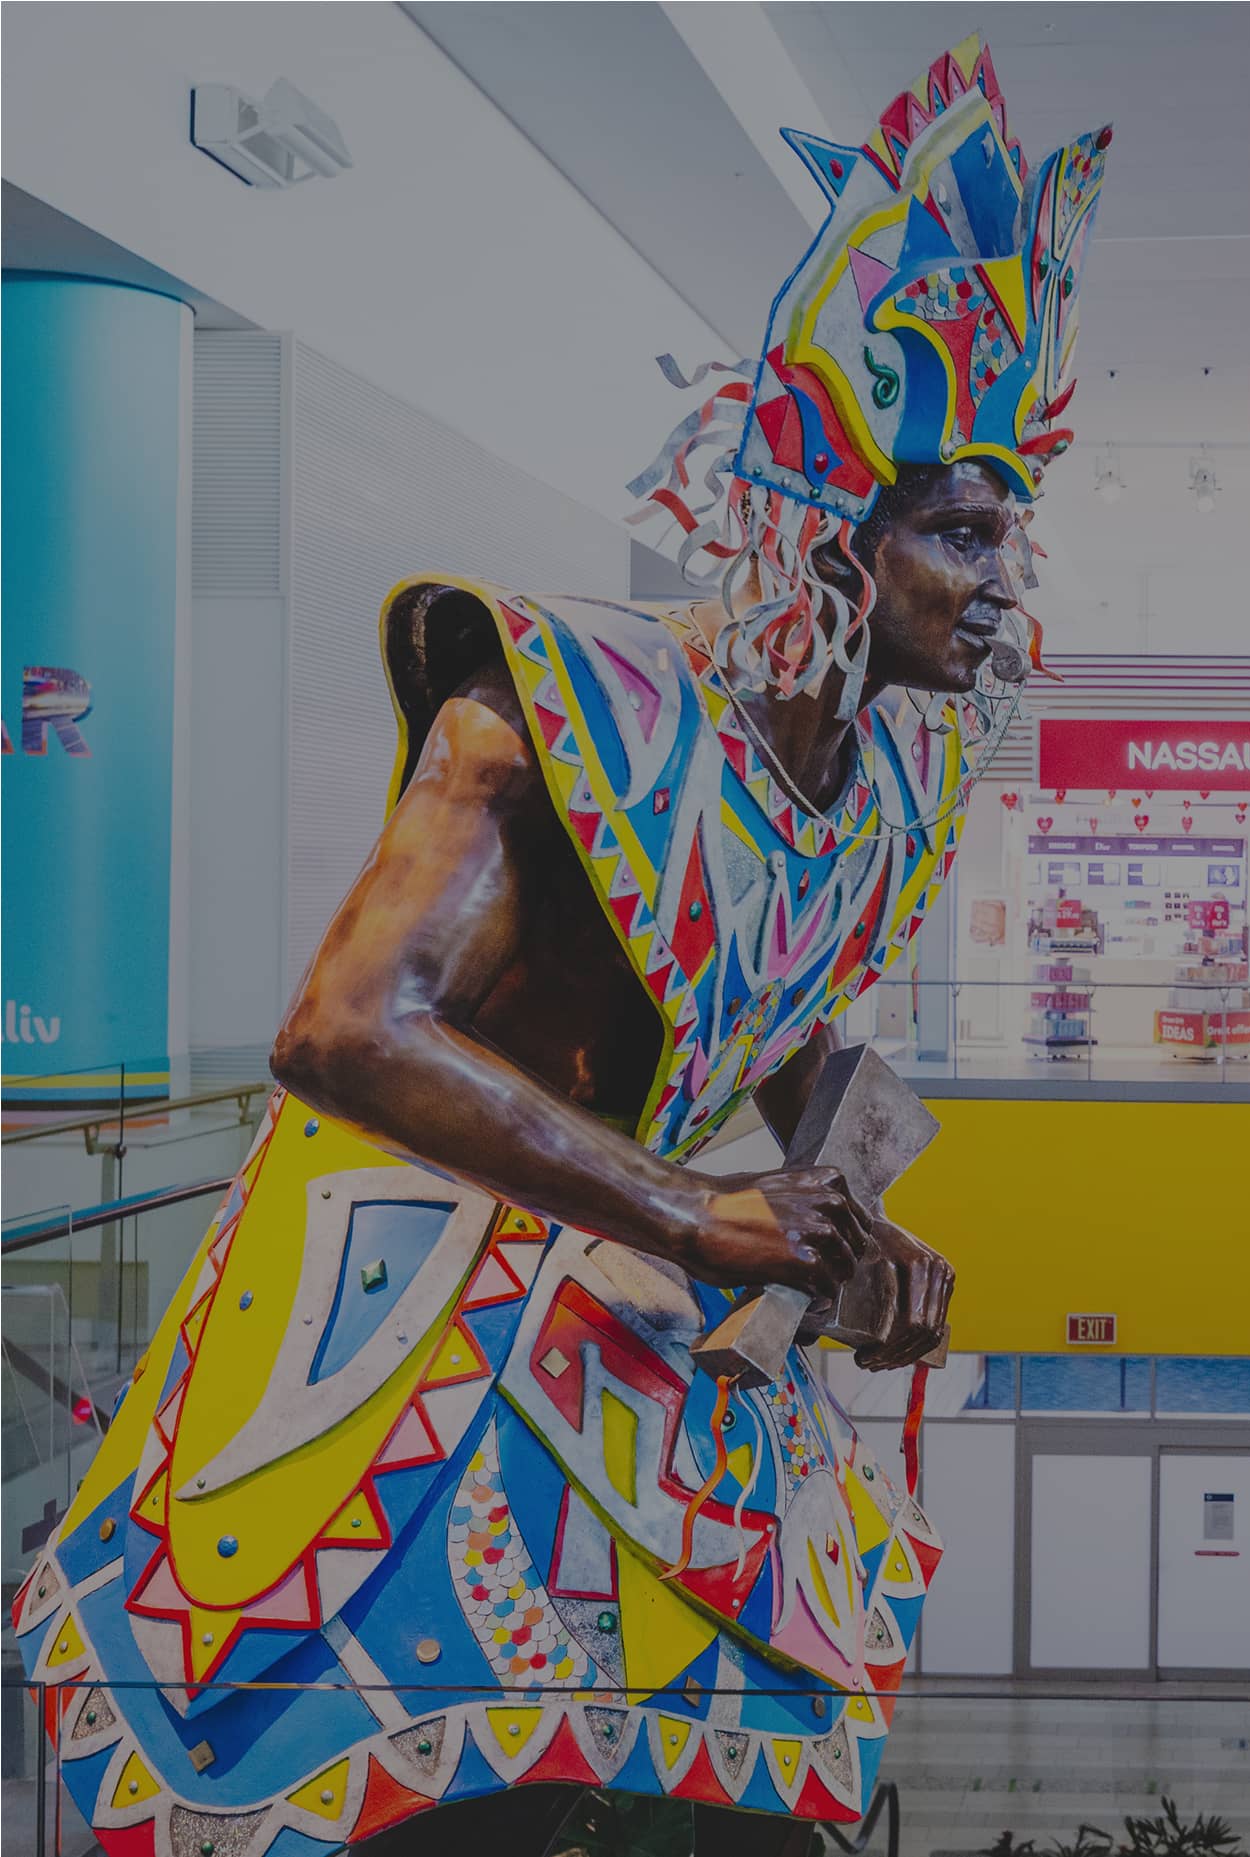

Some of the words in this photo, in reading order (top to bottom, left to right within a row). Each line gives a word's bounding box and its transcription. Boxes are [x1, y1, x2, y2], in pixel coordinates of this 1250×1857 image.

[1, 666, 94, 758] R
[1, 1000, 60, 1044] liv
[1162, 1025, 1195, 1041] IDEAS
[1078, 1318, 1106, 1340] EXIT
